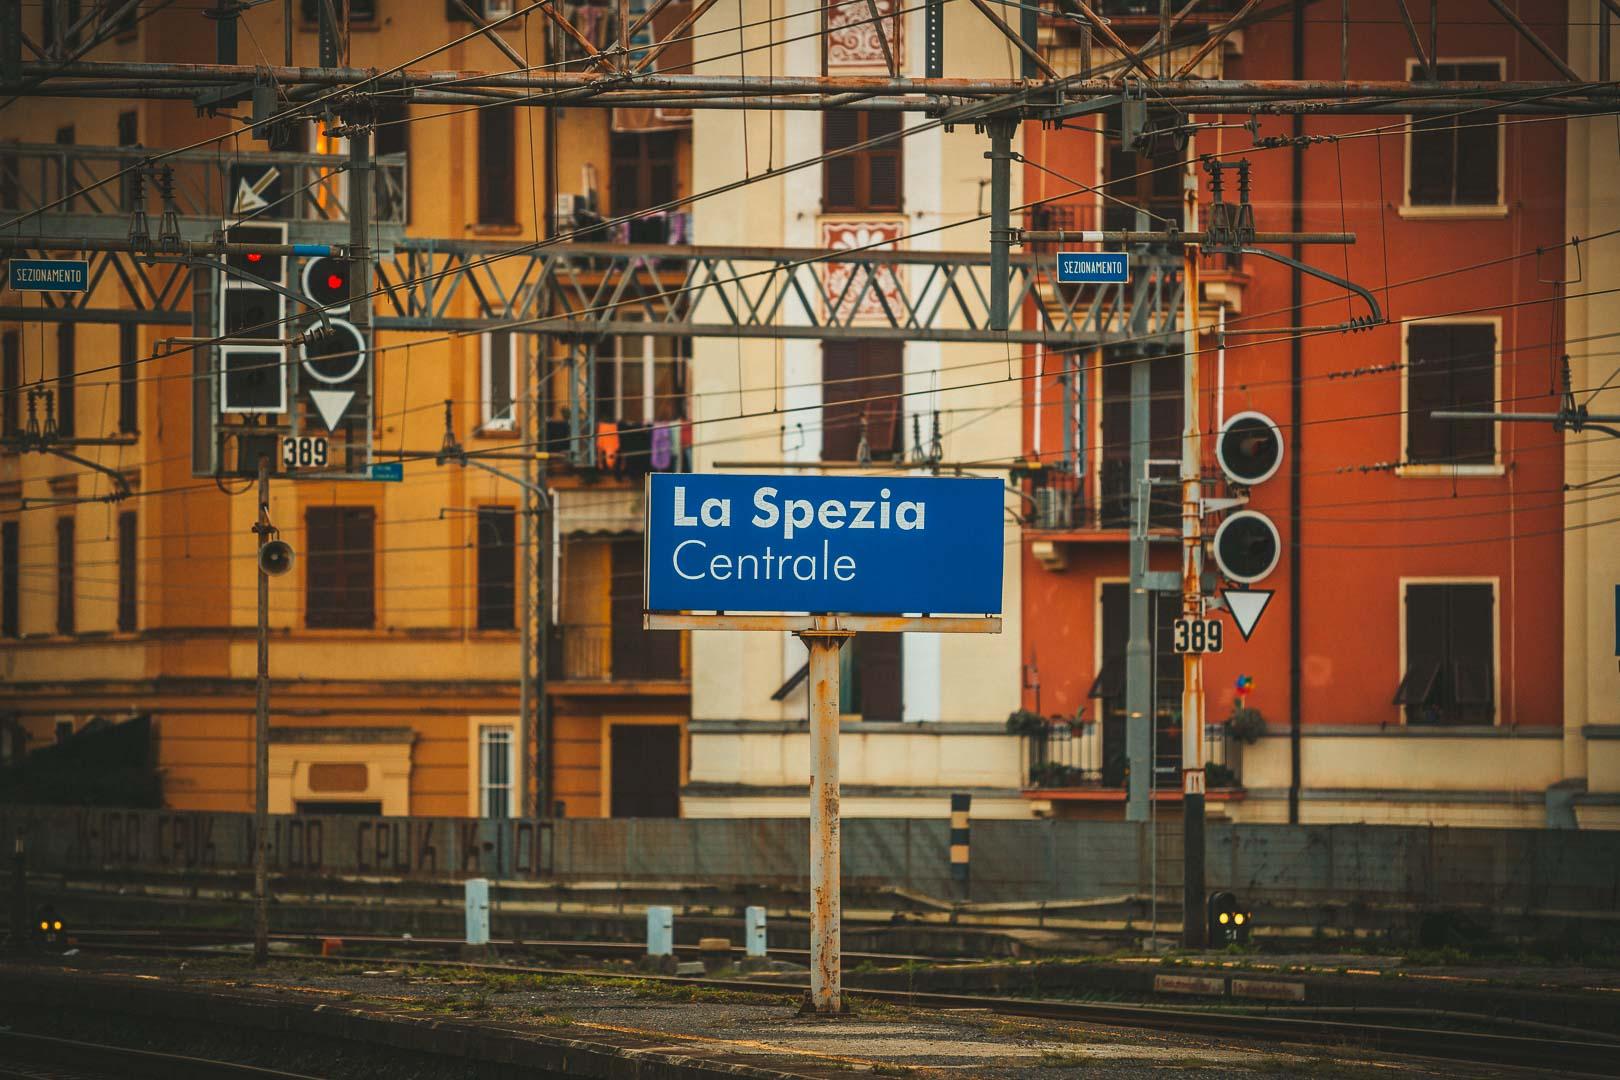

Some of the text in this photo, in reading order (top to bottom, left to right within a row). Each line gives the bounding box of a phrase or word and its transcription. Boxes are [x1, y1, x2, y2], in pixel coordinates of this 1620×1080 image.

[16, 268, 81, 283] SEZIONAMENTO
[1063, 261, 1122, 274] SEZIONAMENTO
[283, 437, 328, 466] 389
[673, 486, 926, 540] La Spezia
[672, 539, 857, 581] Centrale
[1175, 620, 1222, 652] 389
